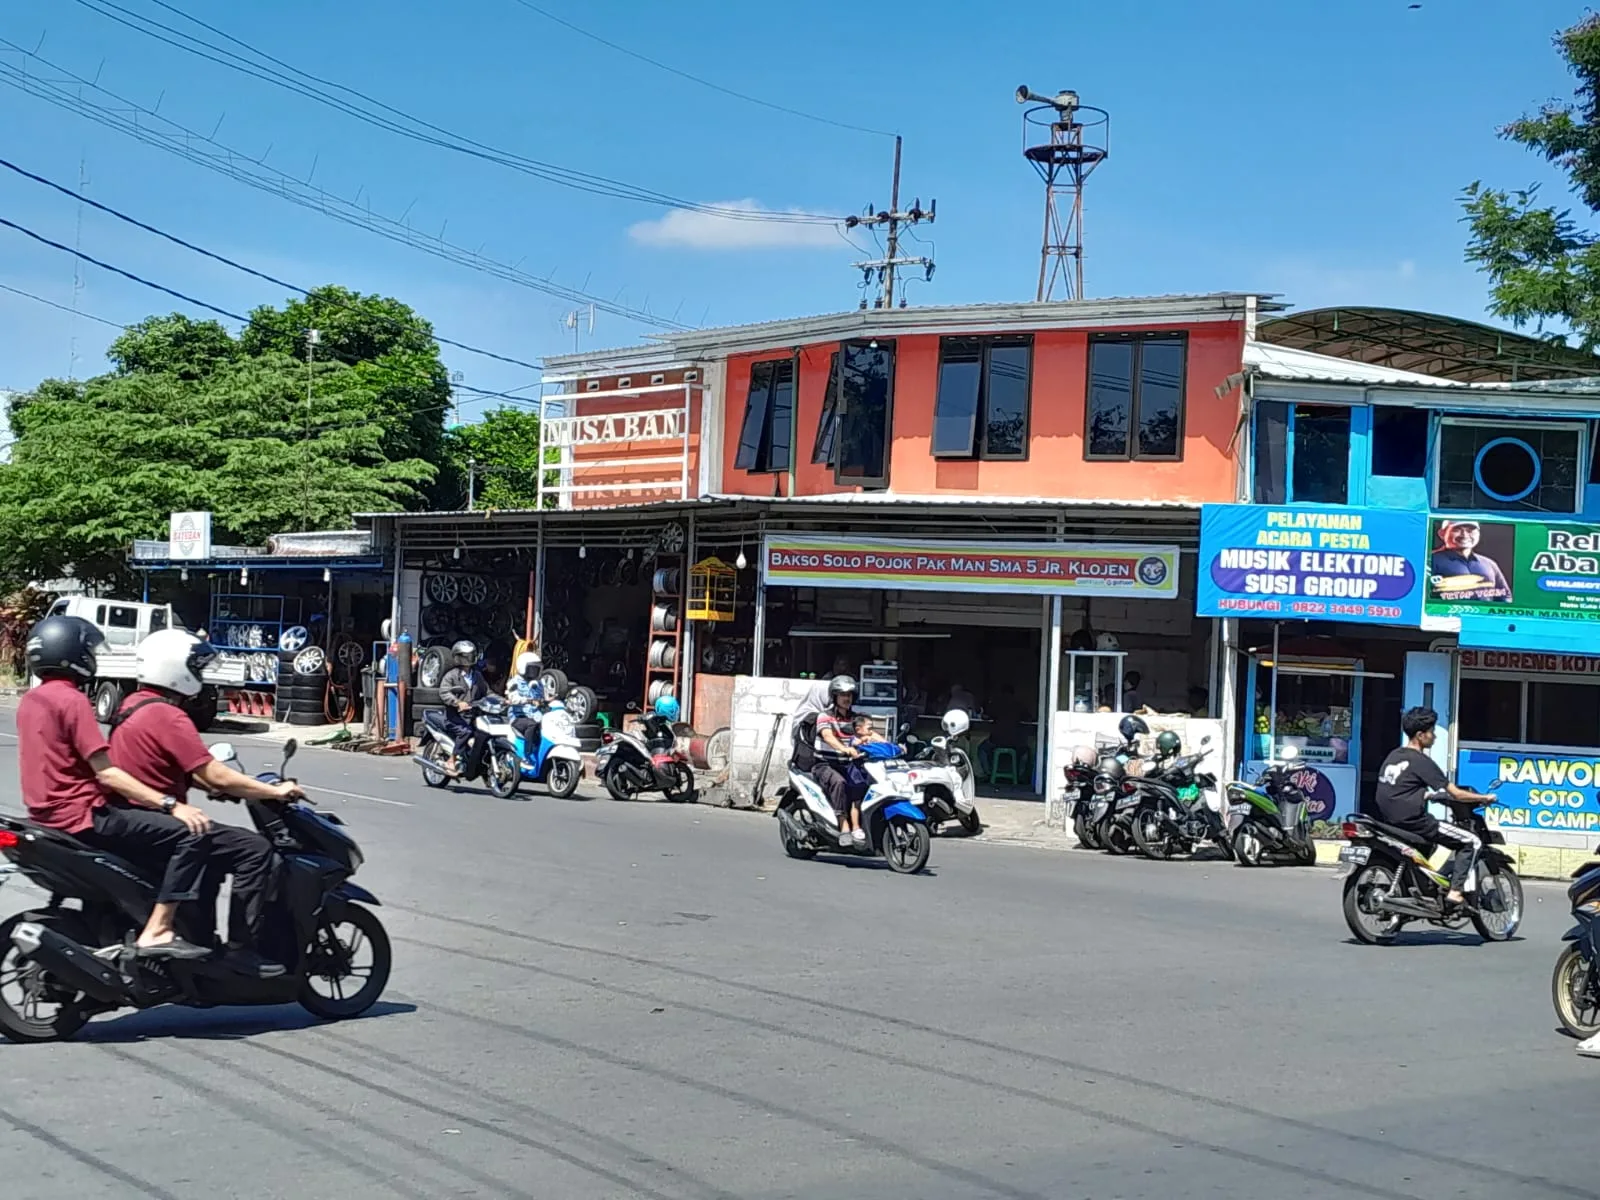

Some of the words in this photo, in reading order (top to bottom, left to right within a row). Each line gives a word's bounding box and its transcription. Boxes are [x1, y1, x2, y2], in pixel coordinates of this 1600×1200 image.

[1267, 511, 1362, 530] PELAYANAN
[1256, 530, 1312, 547] ACARA
[1319, 533, 1370, 550] PESTA
[771, 552, 820, 567] BAKSO
[823, 554, 861, 568] SOLO
[865, 555, 912, 570] POJOK
[917, 556, 946, 571] PAK
[951, 558, 985, 572] MAN
[989, 559, 1022, 573] SMA
[1026, 560, 1037, 574] 5
[1069, 562, 1129, 577] KLOJEN
[1220, 549, 1291, 571] MUSIK
[1300, 551, 1406, 577] ELEKTONE
[1531, 552, 1599, 574] Aba
[1245, 574, 1296, 595] SUSI
[1303, 575, 1378, 599] GROUP
[1218, 599, 1280, 611] HUBUNGI
[1292, 601, 1325, 613] 0822
[1330, 604, 1364, 615] 3449
[1367, 606, 1402, 618] 5910
[1487, 607, 1535, 617] ANTON
[1539, 609, 1584, 619] MANIA
[1484, 651, 1557, 670] GORENG
[1562, 655, 1600, 672] KOT
[1528, 789, 1584, 809] SOTO
[1485, 806, 1530, 826] NASI
[1537, 810, 1600, 830] CAMP
